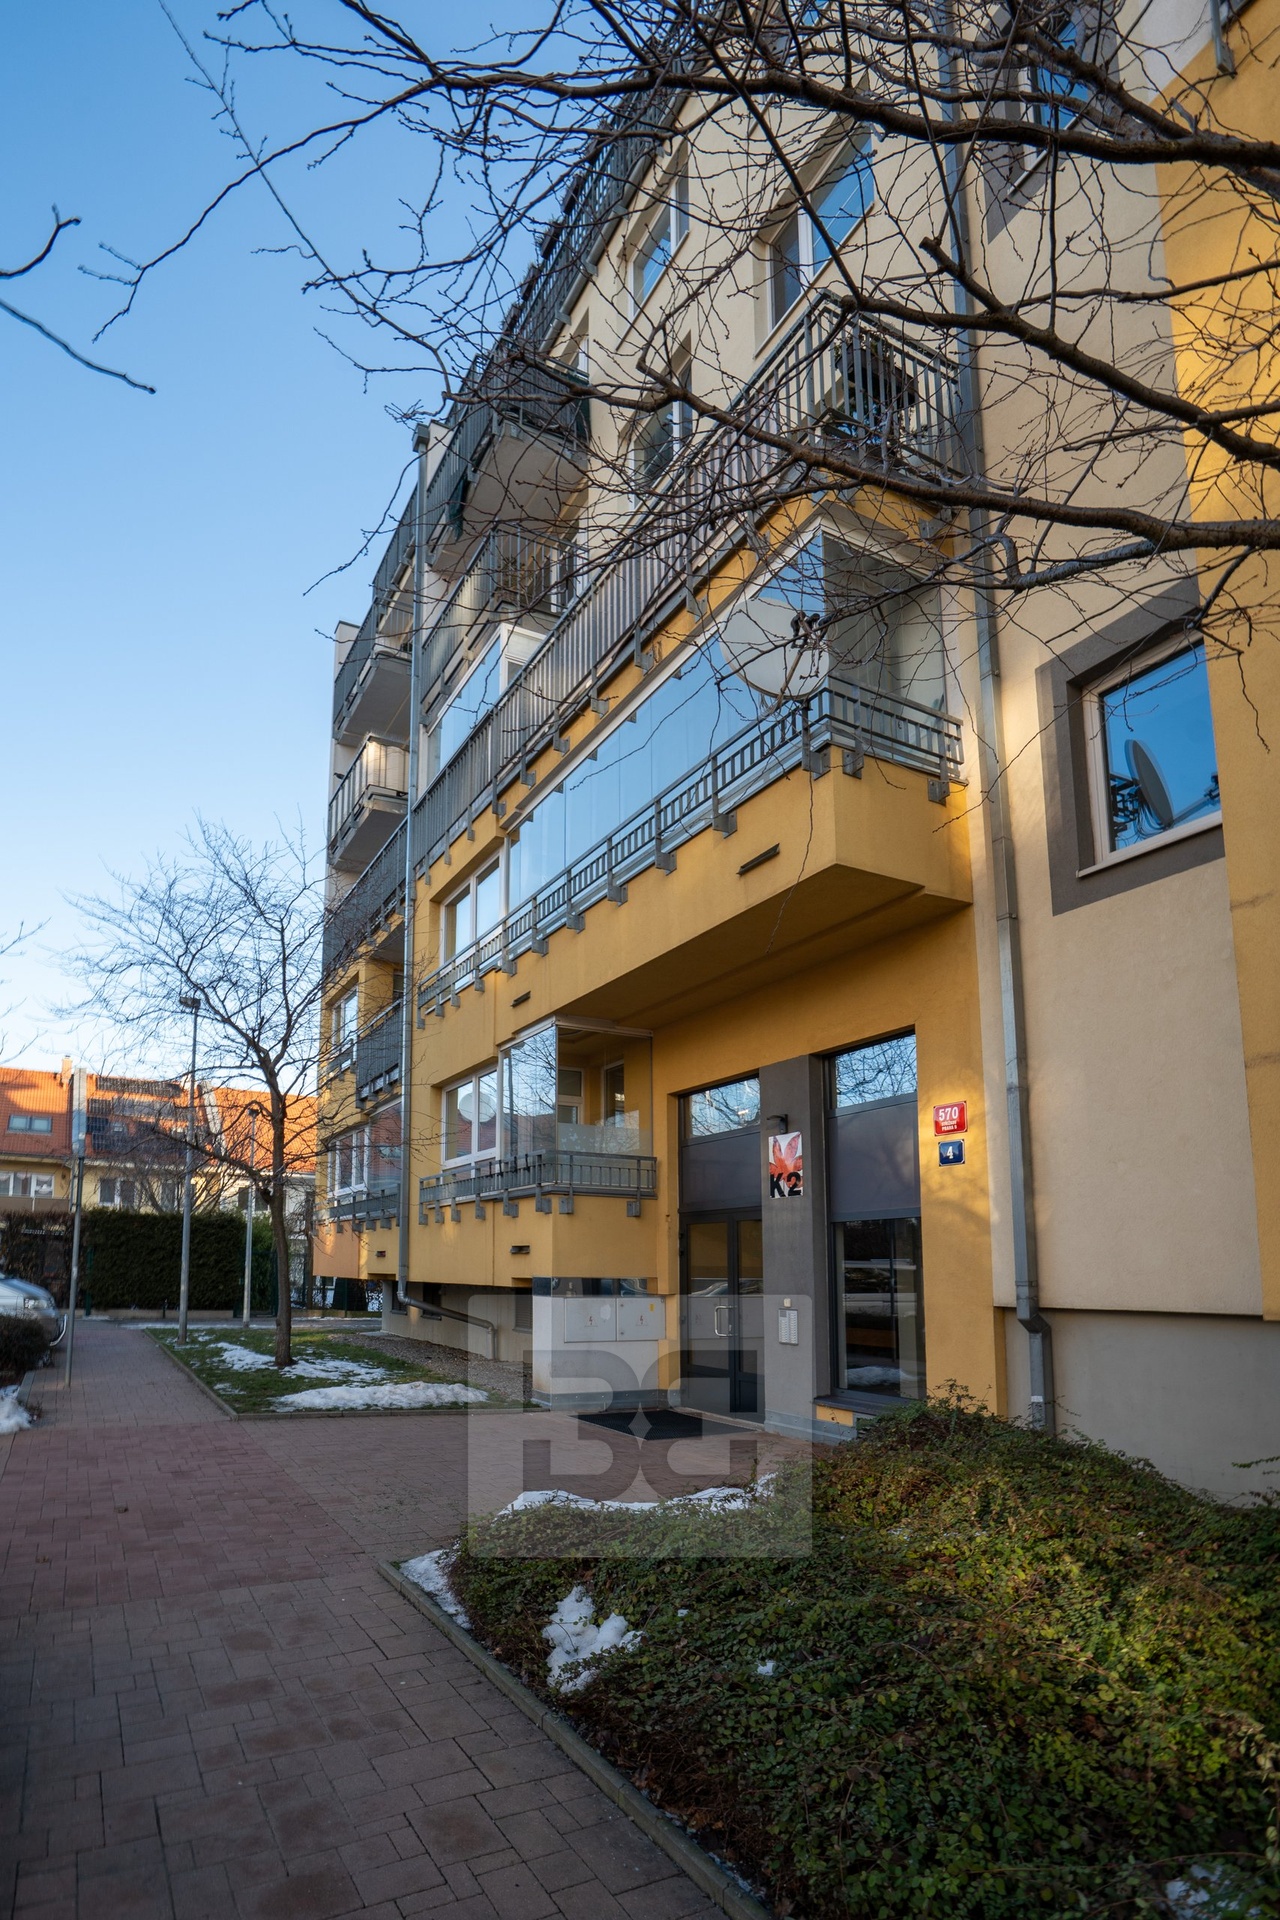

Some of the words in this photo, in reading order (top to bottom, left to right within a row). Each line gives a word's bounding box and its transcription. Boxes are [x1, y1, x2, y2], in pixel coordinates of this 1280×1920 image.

[939, 1107, 958, 1121] 570
[946, 1146, 954, 1159] 4
[769, 1171, 802, 1198] K2
